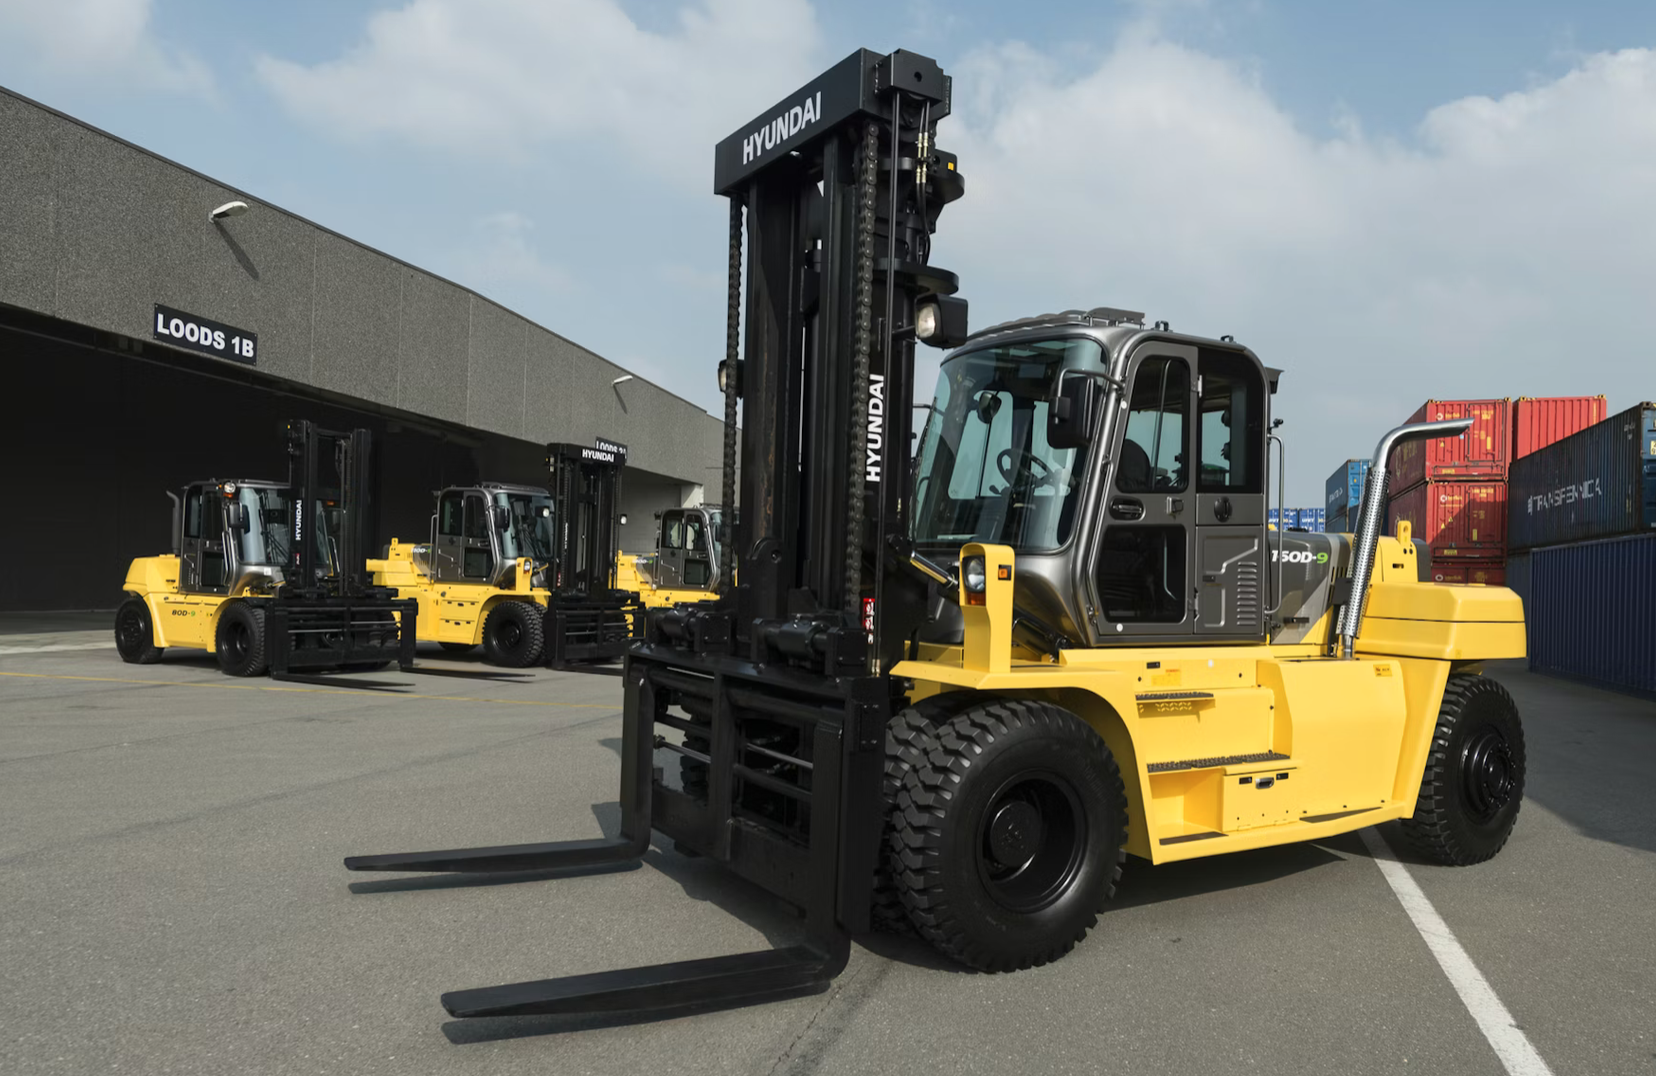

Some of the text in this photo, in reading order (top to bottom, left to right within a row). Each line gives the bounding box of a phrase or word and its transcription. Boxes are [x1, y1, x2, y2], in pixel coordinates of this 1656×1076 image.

[743, 91, 822, 165] HYUNDAI
[157, 313, 254, 358] LOODS 1B
[582, 449, 615, 462] HYUNDAI
[866, 374, 884, 482] HYUNDAI
